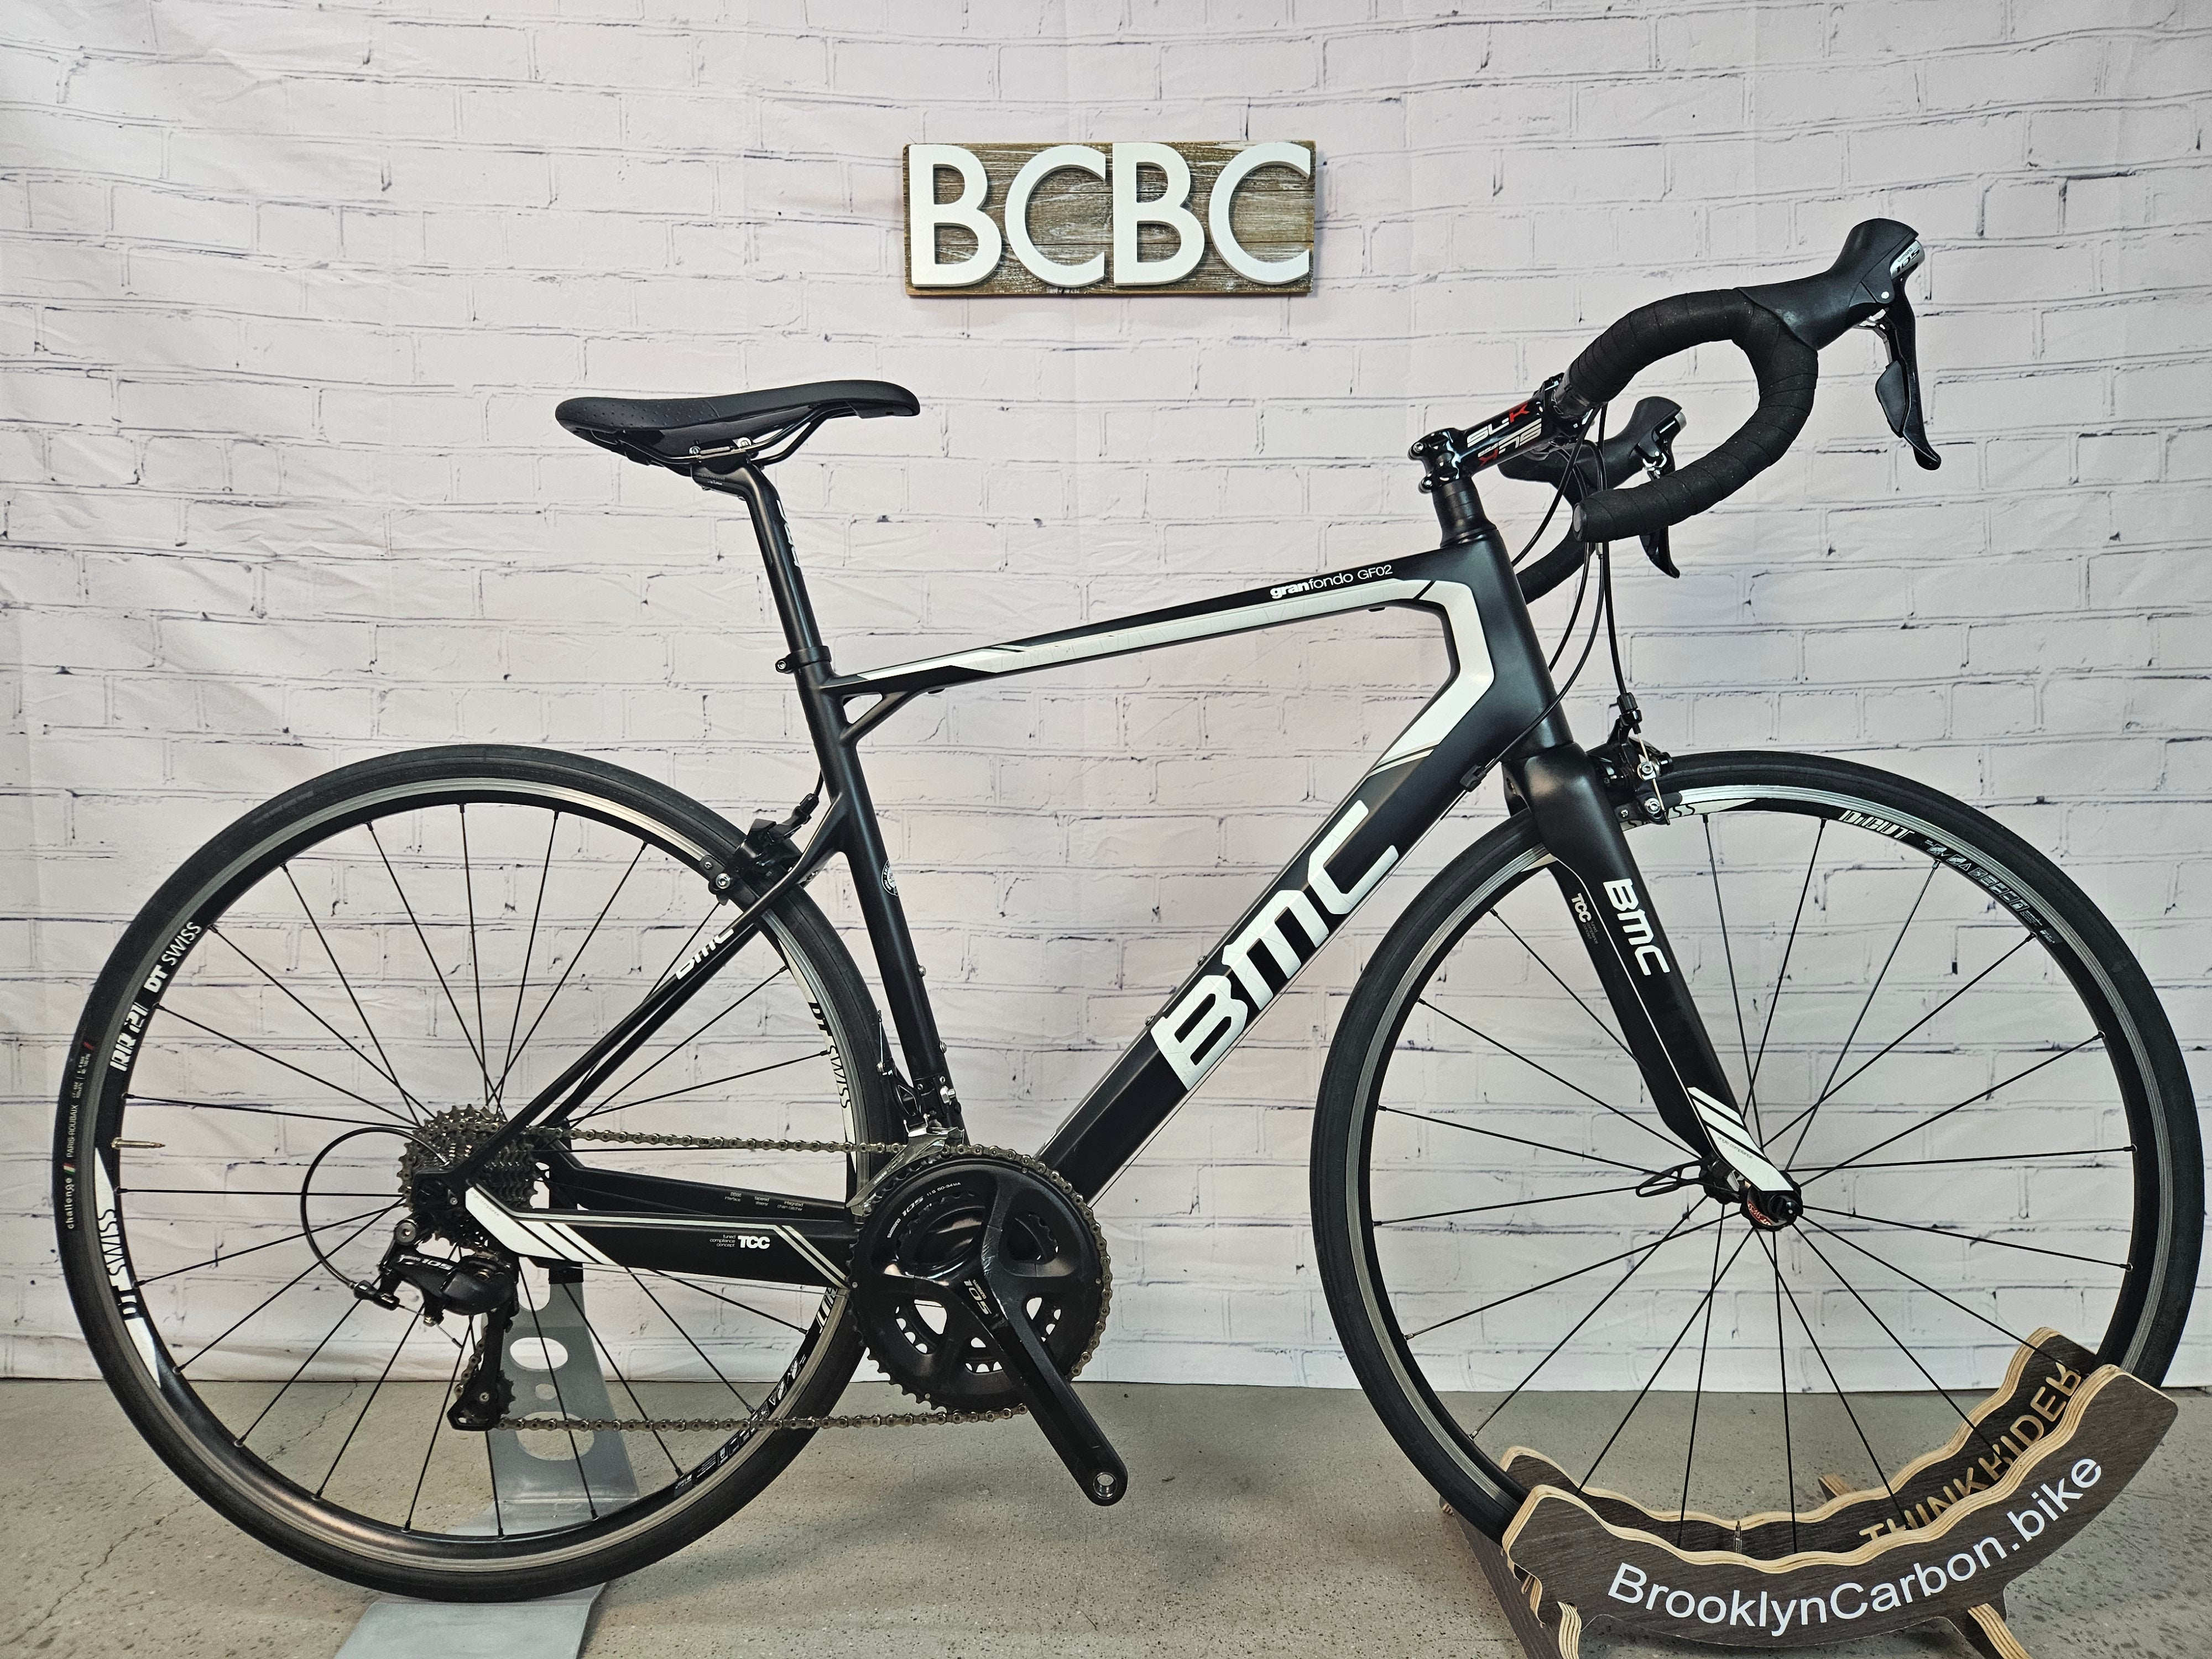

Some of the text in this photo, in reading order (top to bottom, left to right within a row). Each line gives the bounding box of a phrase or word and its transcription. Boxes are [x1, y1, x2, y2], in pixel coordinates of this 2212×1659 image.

[909, 142, 1311, 287] BCBC
[1896, 247, 1920, 273] 105
[1357, 565, 1394, 580] GF02
[1571, 893, 1592, 923] TCC
[1603, 878, 1671, 975] BMC
[143, 964, 169, 993] DT
[161, 921, 202, 966] SWISS
[1150, 800, 1399, 1091] BMC
[901, 1196, 924, 1217] 105
[737, 1235, 770, 1249] TCC
[422, 1259, 455, 1270] 105
[963, 1279, 992, 1314] 105
[1608, 1458, 2101, 1637] BrooklynCarbon.bike
